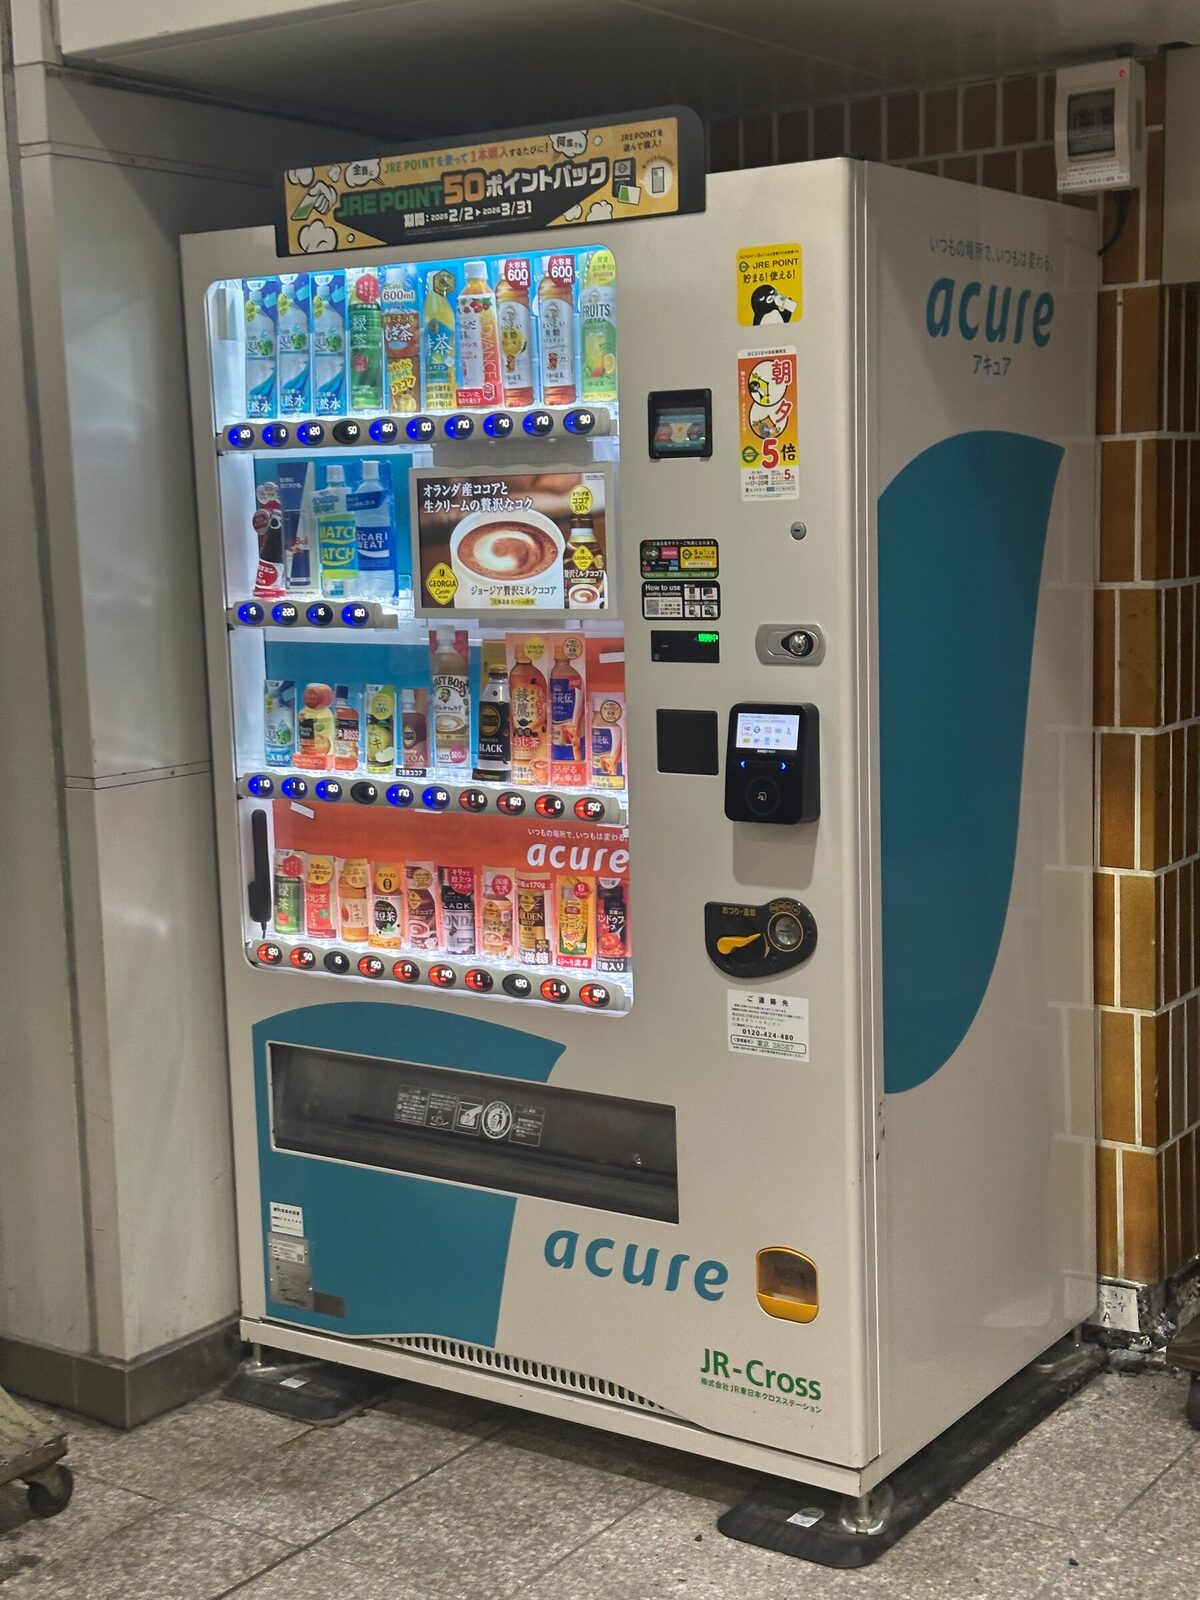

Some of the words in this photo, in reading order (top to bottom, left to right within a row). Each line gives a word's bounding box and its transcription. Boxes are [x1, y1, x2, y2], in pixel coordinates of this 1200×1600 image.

[384, 161, 402, 174] JRE
[551, 257, 572, 266] 大容量
[752, 260, 770, 269] JRE
[772, 257, 799, 267] POINT
[507, 268, 529, 282] 600
[551, 265, 573, 279] 600
[383, 290, 416, 301] 600ml
[582, 303, 610, 318] FRUITS
[925, 276, 1055, 348] acure
[771, 360, 791, 385] 朝
[972, 354, 1012, 377] アキュア
[423, 481, 508, 496] オランダ産ココアと
[423, 497, 533, 514] 生クリームの贅沢なコク
[429, 579, 457, 588] GEORGIA
[526, 843, 630, 874] acure
[543, 1229, 729, 1302] acure
[700, 1348, 822, 1402] JR-Cross
